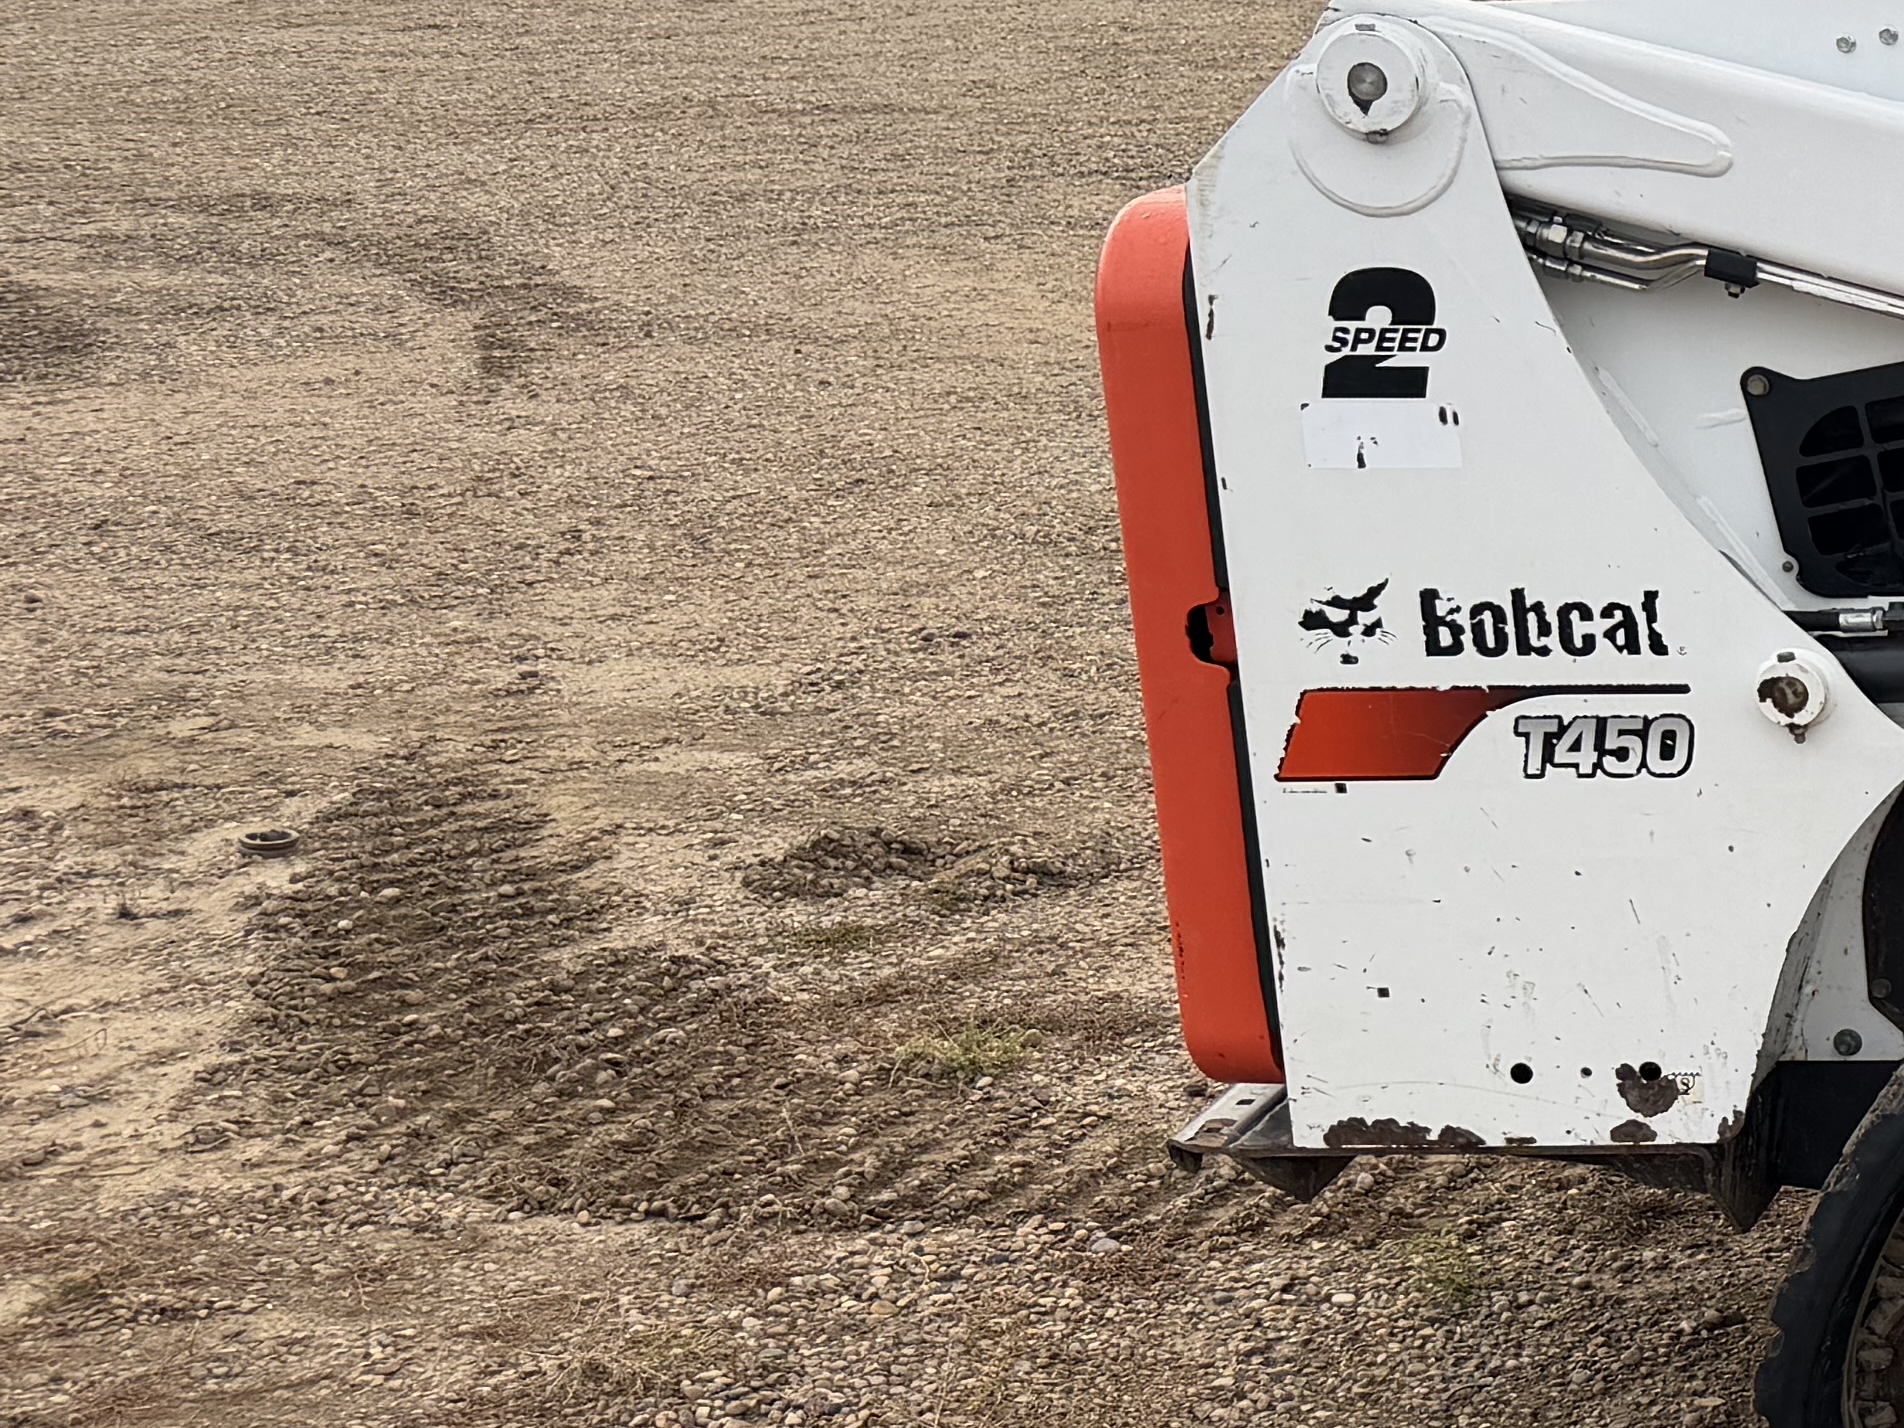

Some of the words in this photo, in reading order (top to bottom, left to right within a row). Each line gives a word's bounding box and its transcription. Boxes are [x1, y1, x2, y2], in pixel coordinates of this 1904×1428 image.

[1320, 266, 1437, 399] 2
[1324, 326, 1448, 353] SPEED
[1418, 587, 1670, 658] Bobcat
[1513, 713, 1695, 780] T450
